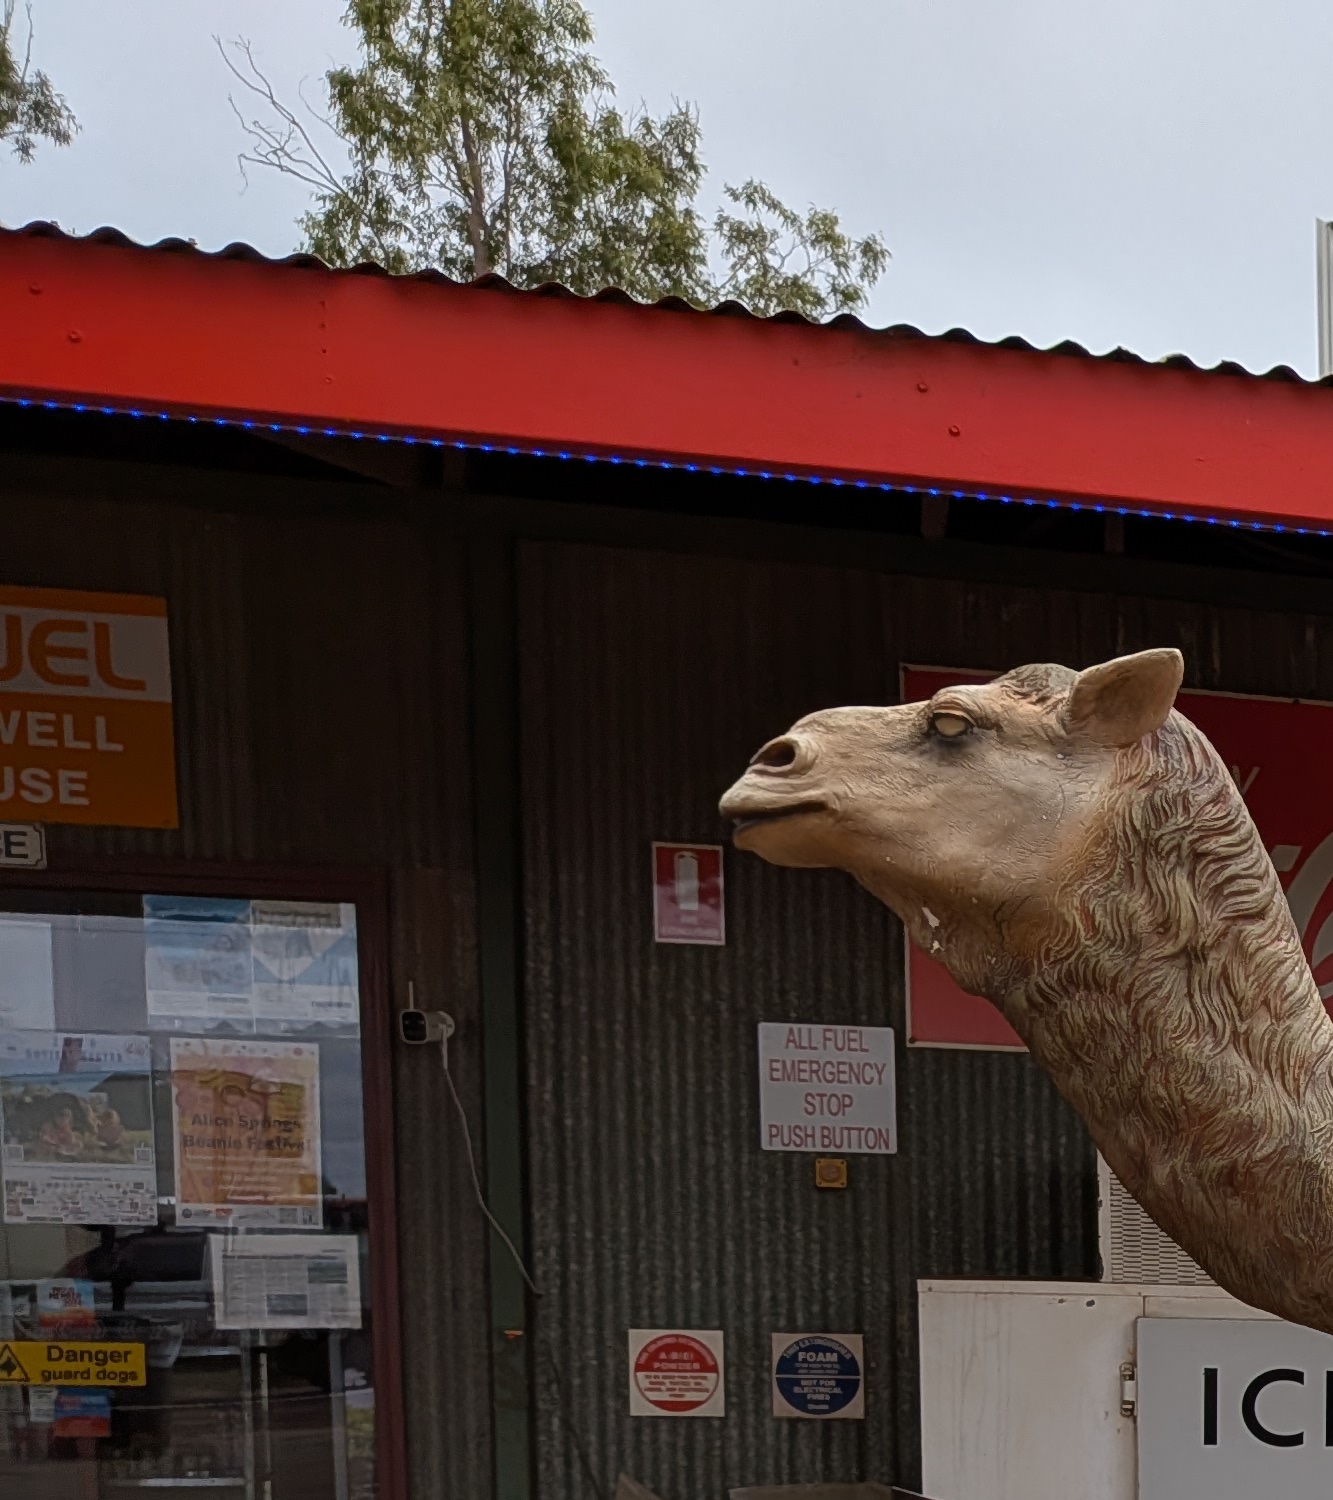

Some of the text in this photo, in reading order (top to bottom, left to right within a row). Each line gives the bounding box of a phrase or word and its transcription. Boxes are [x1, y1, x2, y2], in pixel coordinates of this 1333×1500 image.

[785, 1027, 869, 1053] ALL FUEL
[768, 1058, 886, 1085] EMERGENCY
[804, 1092, 853, 1116] STOP
[768, 1124, 889, 1150] PUSH BUTTON
[47, 1345, 132, 1366] Danger
[798, 1351, 838, 1362] FOAM
[41, 1368, 138, 1383] guard dogs
